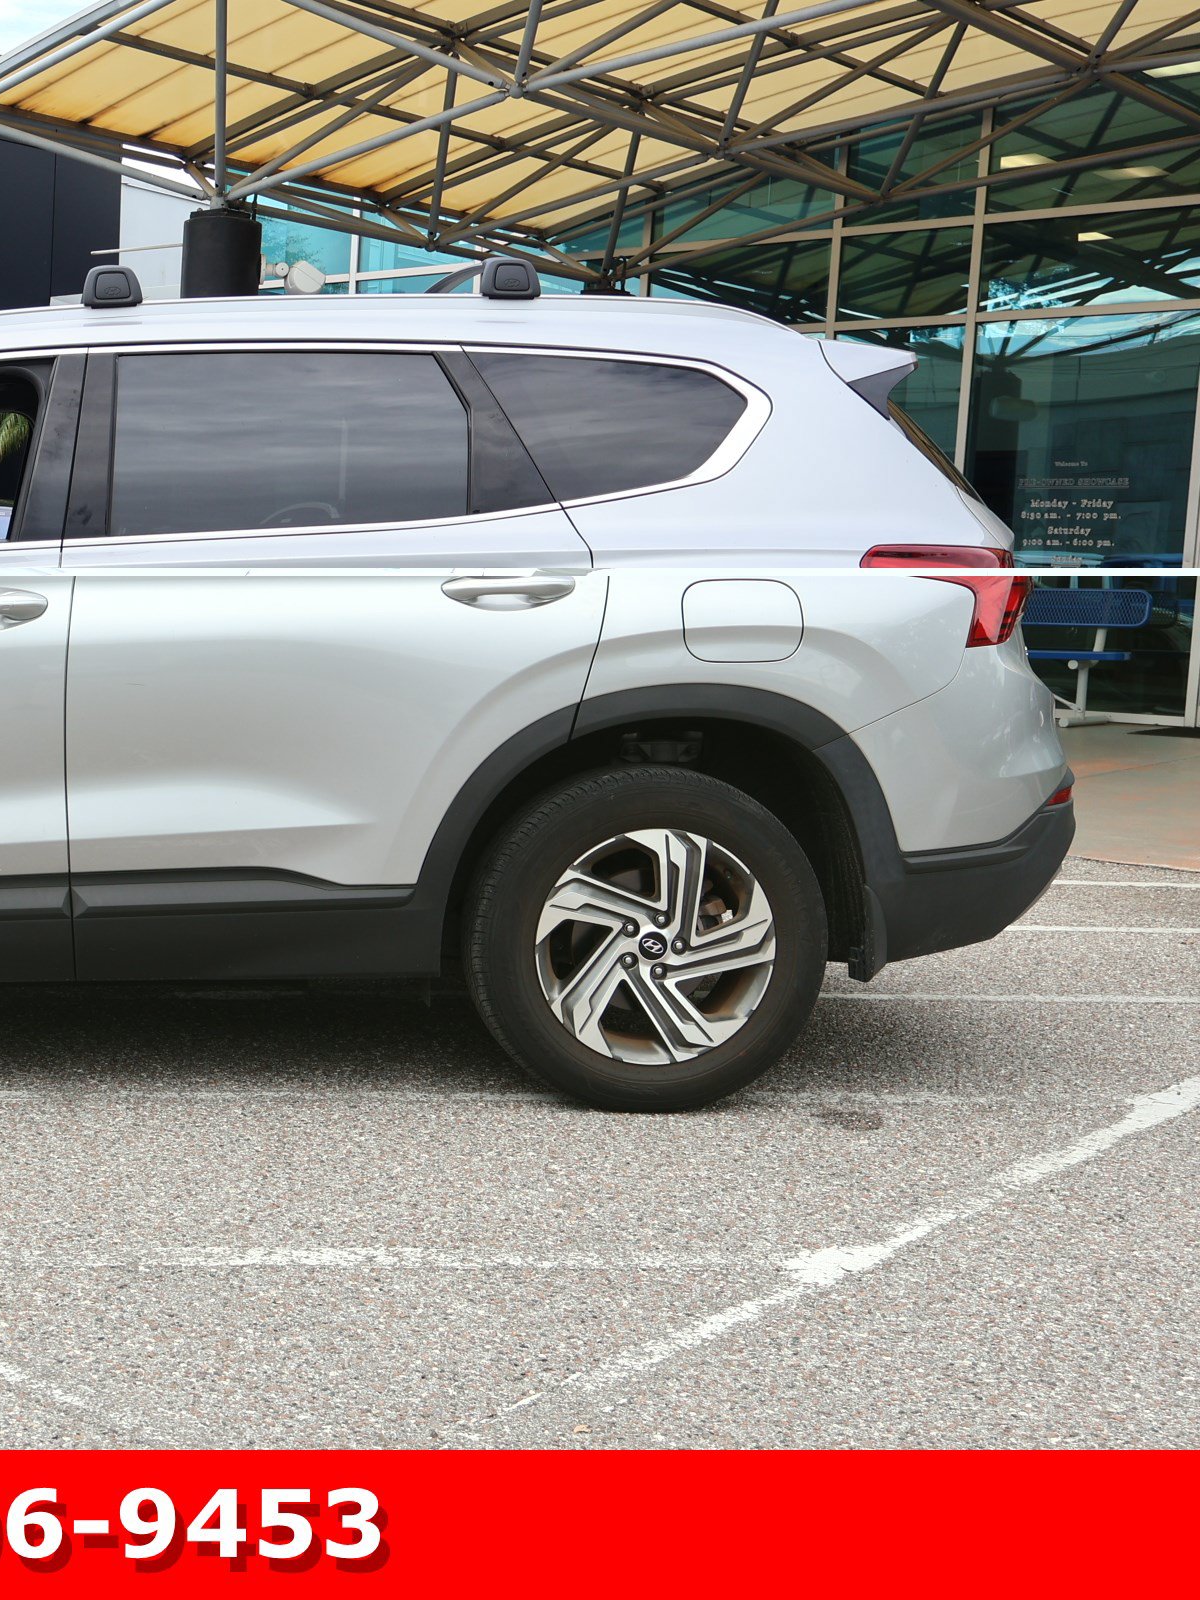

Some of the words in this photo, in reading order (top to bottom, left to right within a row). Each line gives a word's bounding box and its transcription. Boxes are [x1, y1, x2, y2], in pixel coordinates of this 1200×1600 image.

[1077, 477, 1130, 487] SHOWCASE
[1030, 498, 1069, 509] Monday
[1080, 498, 1114, 509] Friday
[1020, 511, 1042, 520] 8:30
[1076, 512, 1099, 520] 7:00
[1103, 512, 1122, 521] pm.
[1047, 525, 1092, 537] Saturday
[1022, 538, 1043, 547] 9:00
[1072, 538, 1094, 547] 6:00
[1097, 539, 1115, 548] pm.
